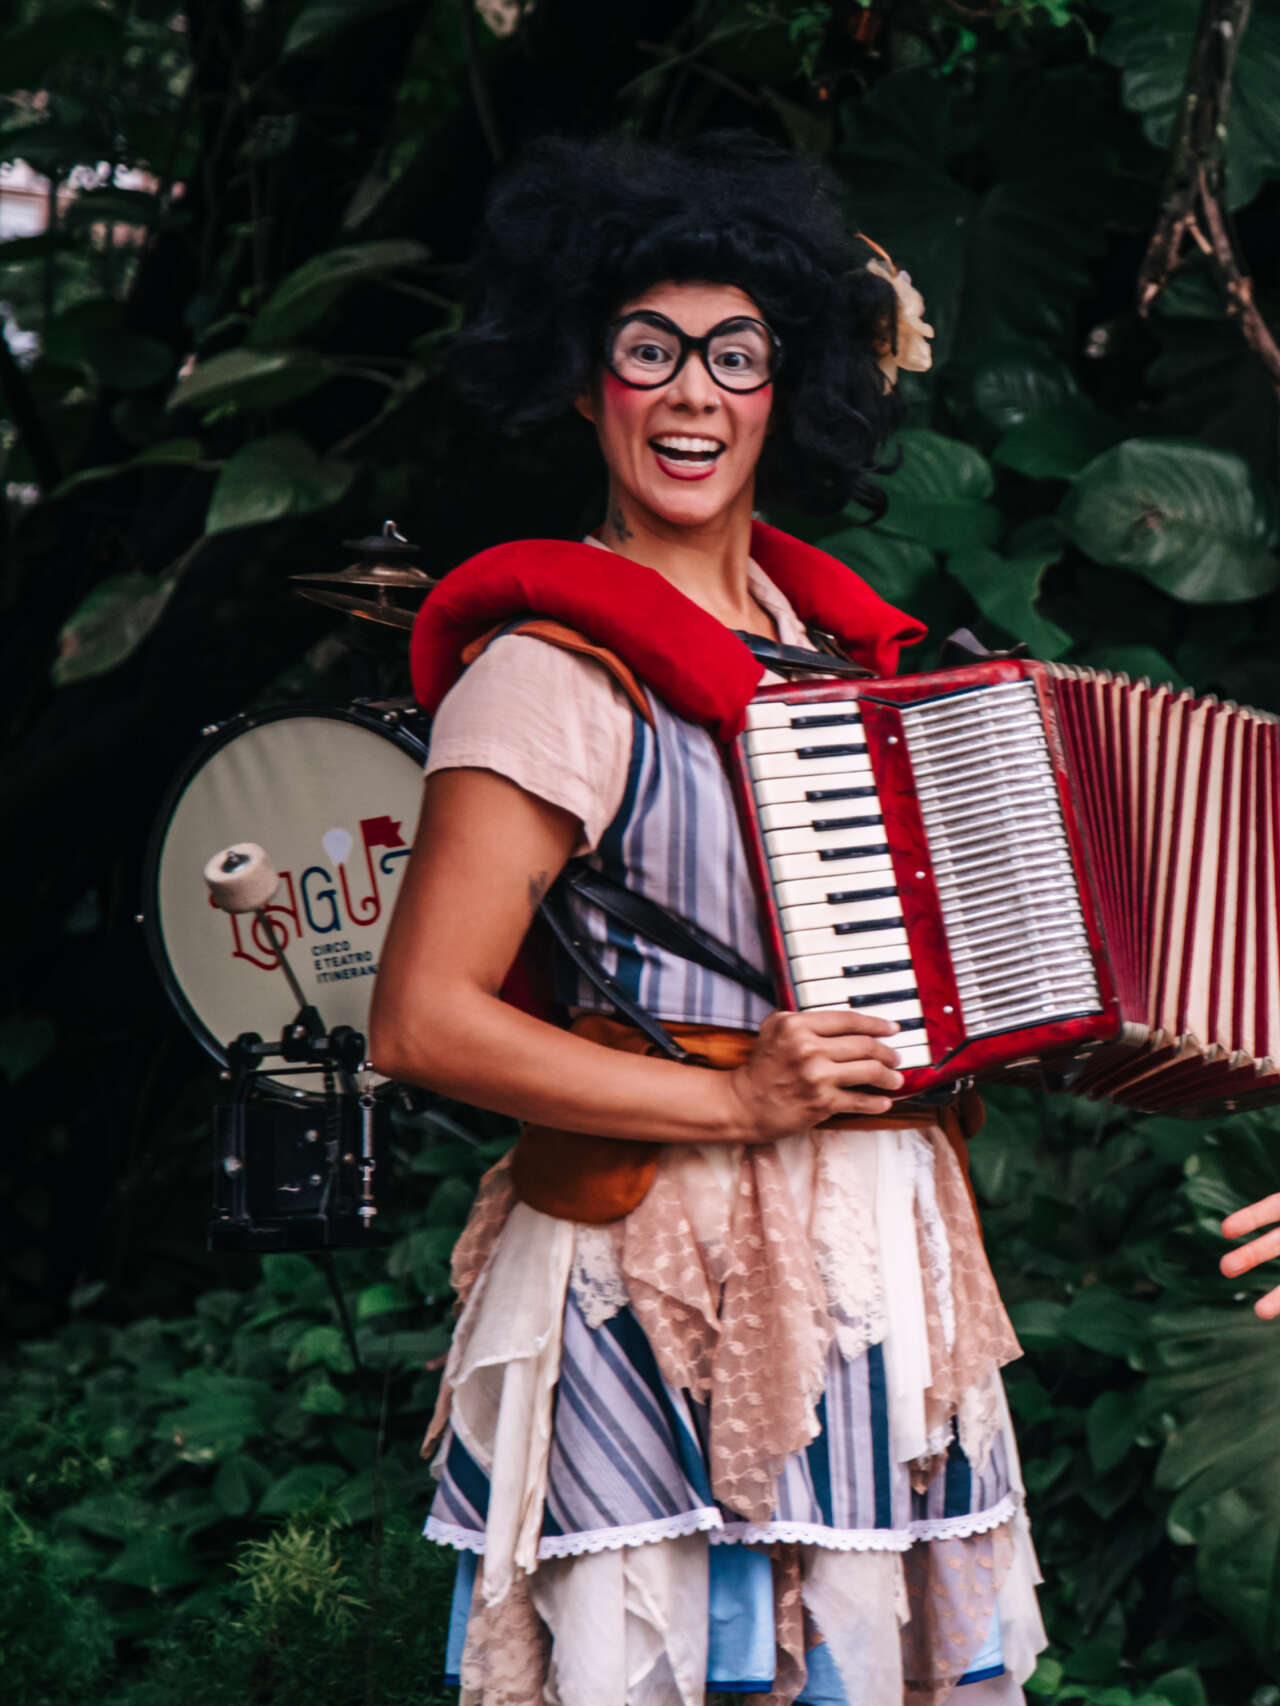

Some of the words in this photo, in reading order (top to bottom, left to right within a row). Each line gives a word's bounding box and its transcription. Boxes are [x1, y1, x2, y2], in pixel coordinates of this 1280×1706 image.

[312, 940, 351, 957] CIRCO
[314, 959, 323, 971] E
[323, 950, 373, 968] TEATRO
